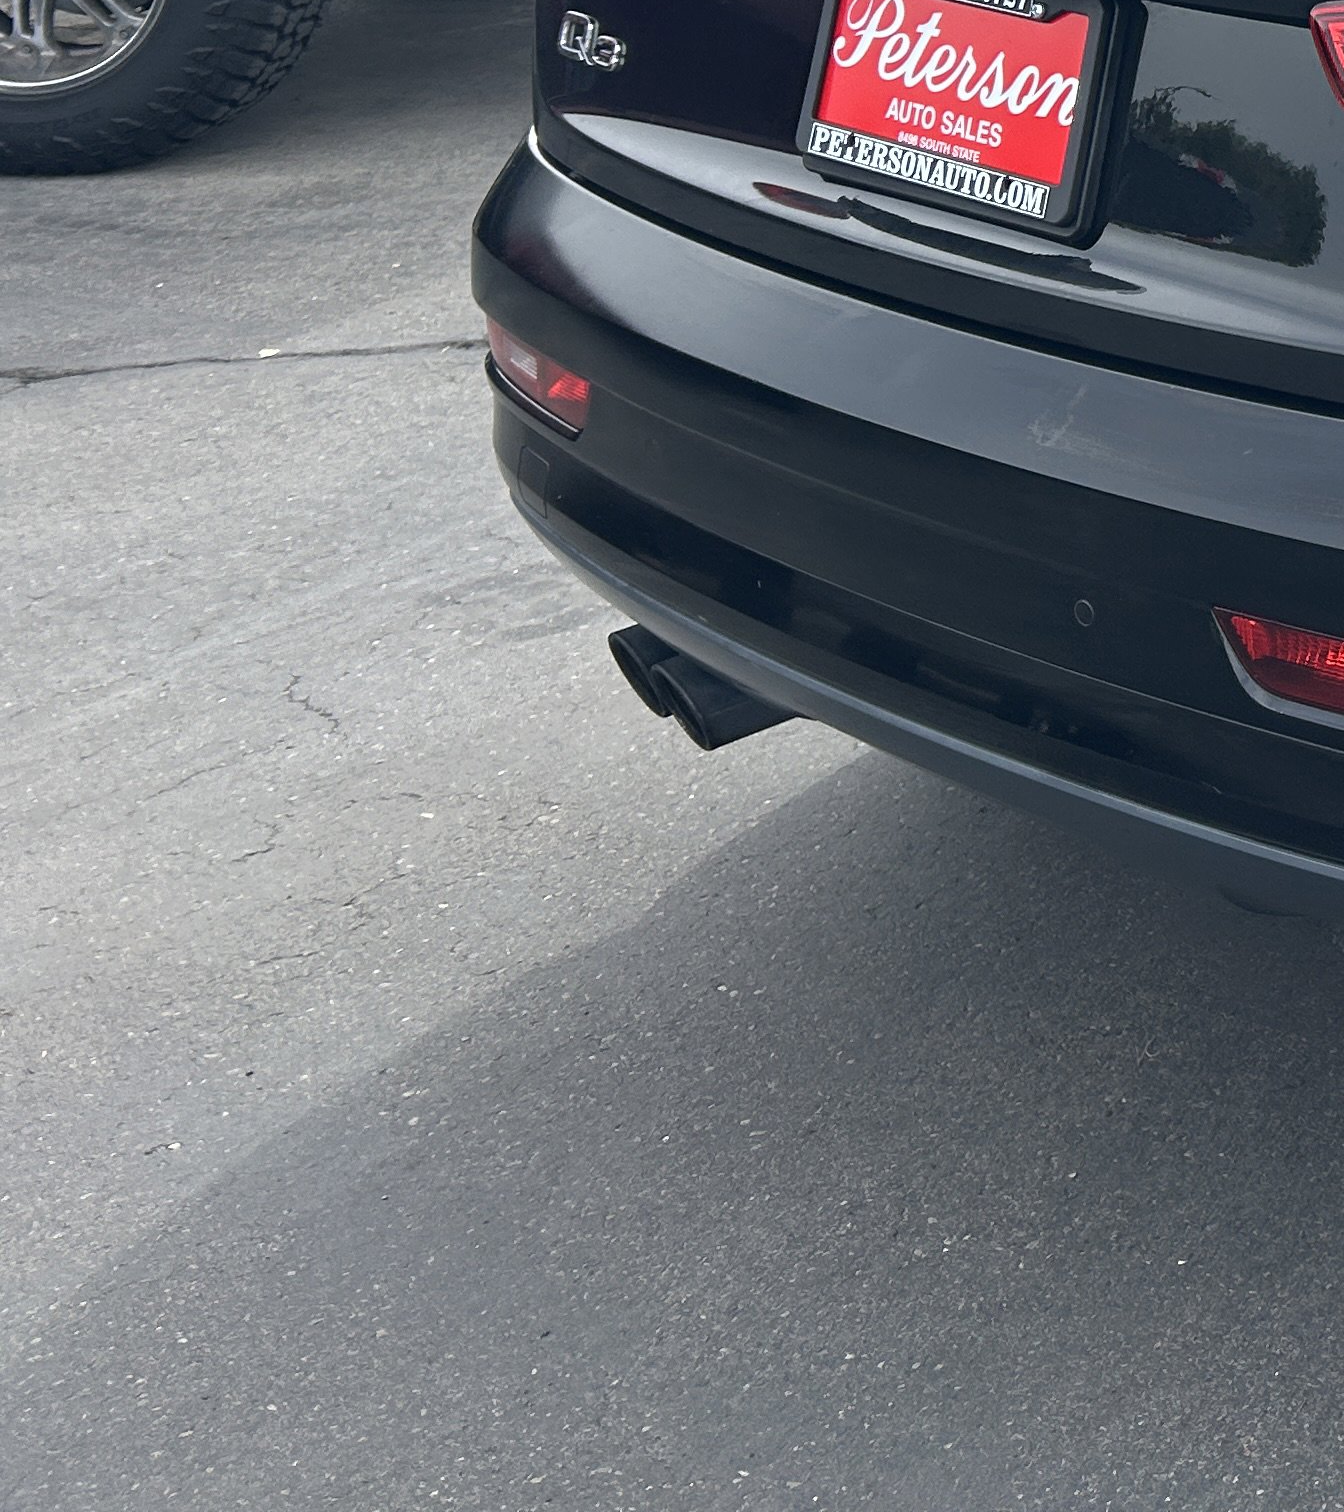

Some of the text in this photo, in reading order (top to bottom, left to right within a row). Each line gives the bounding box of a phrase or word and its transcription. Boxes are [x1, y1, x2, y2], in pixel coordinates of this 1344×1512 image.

[560, 10, 626, 71] Q3
[885, 97, 1003, 148] AUTO SALES
[919, 136, 952, 155] SOUTH
[952, 145, 981, 163] STATE
